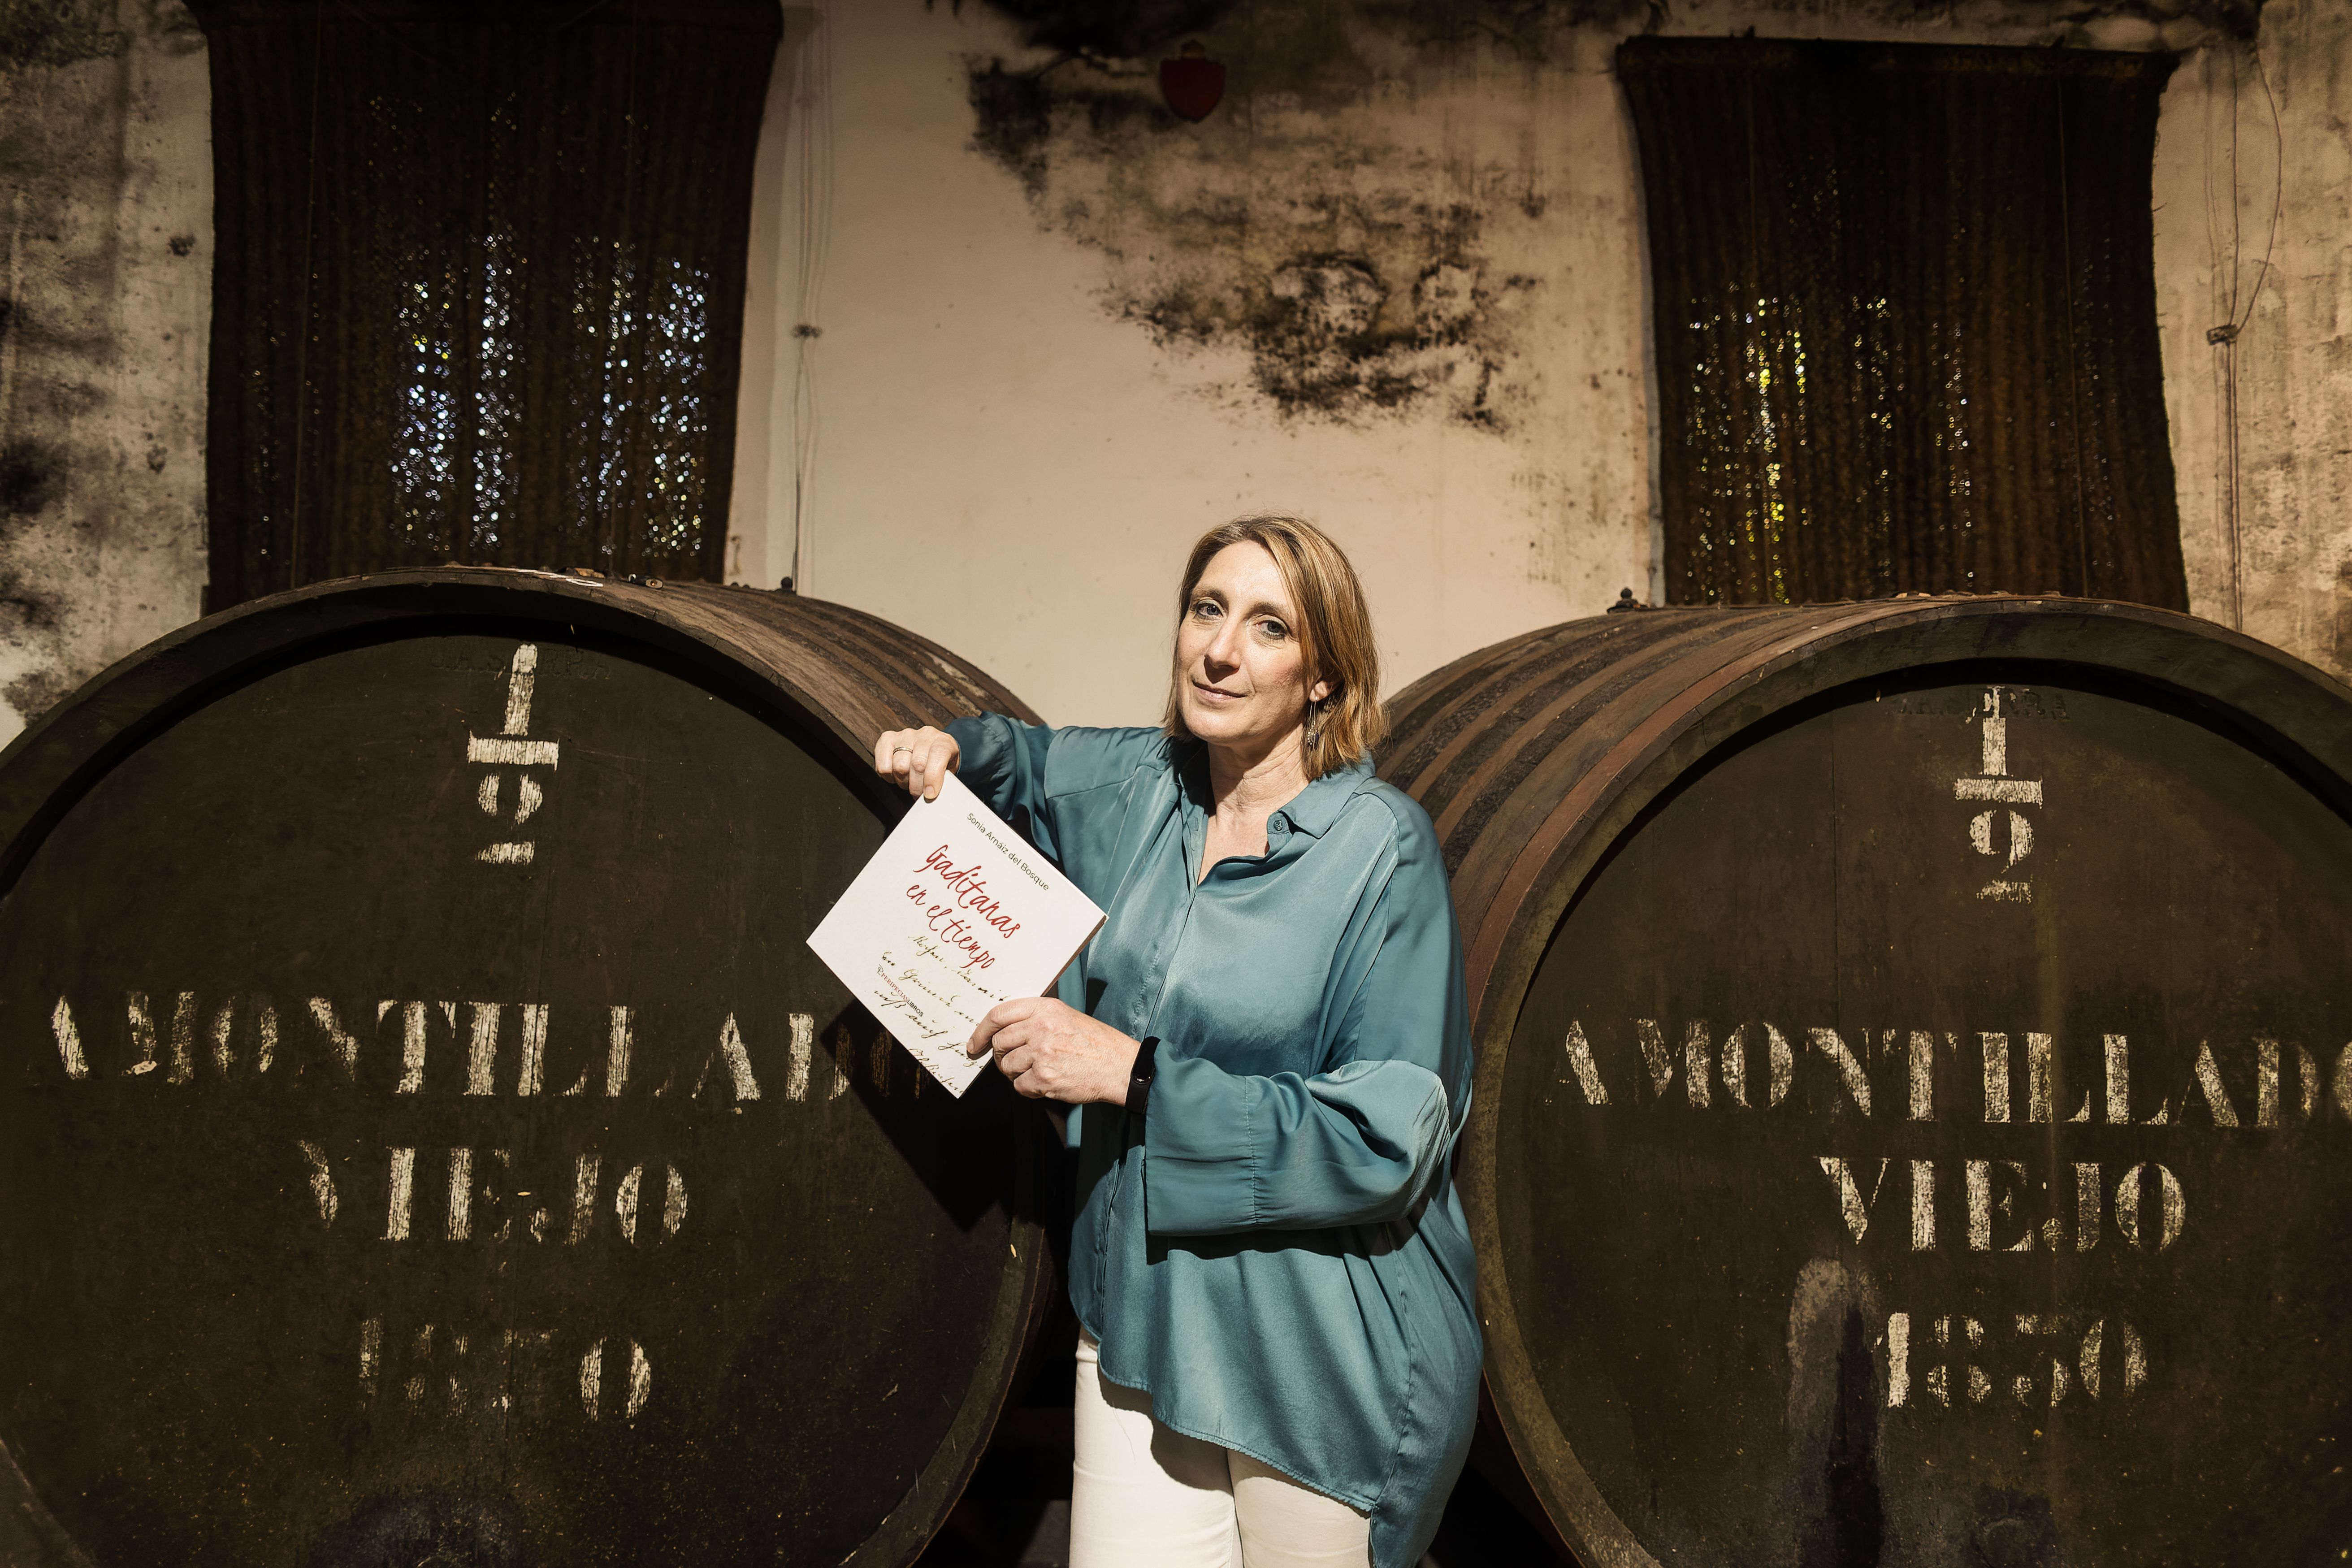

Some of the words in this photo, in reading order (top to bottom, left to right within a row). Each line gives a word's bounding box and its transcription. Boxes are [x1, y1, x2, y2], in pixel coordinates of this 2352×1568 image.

[913, 844, 1020, 938] Gaditanas
[967, 813, 986, 834] Sonia
[985, 832, 1009, 854] Arnáiz
[1008, 853, 1022, 866] del
[1020, 863, 1049, 891] Bosque
[906, 884, 927, 905] en
[927, 905, 953, 931] el
[941, 918, 995, 969] tiempo
[1546, 1018, 2352, 1127] AMONTILLAD
[1815, 1156, 2187, 1253] VIEJO
